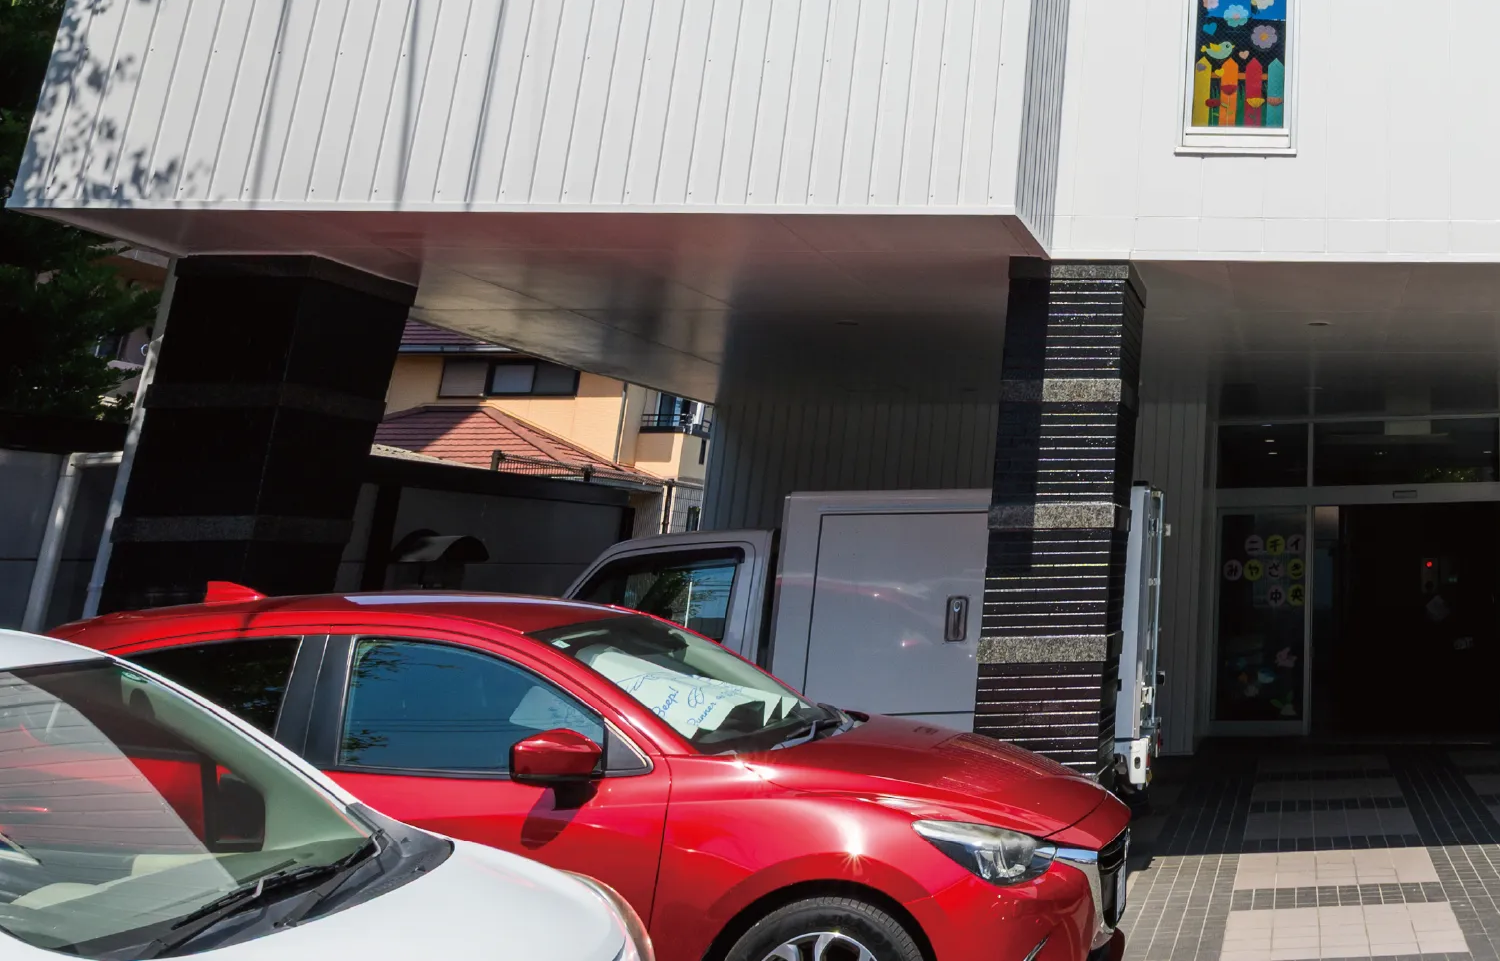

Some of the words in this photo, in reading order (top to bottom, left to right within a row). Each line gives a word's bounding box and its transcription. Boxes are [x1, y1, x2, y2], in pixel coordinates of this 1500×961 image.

[1247, 537, 1302, 553] ニチイ
[1269, 585, 1304, 604] 中央
